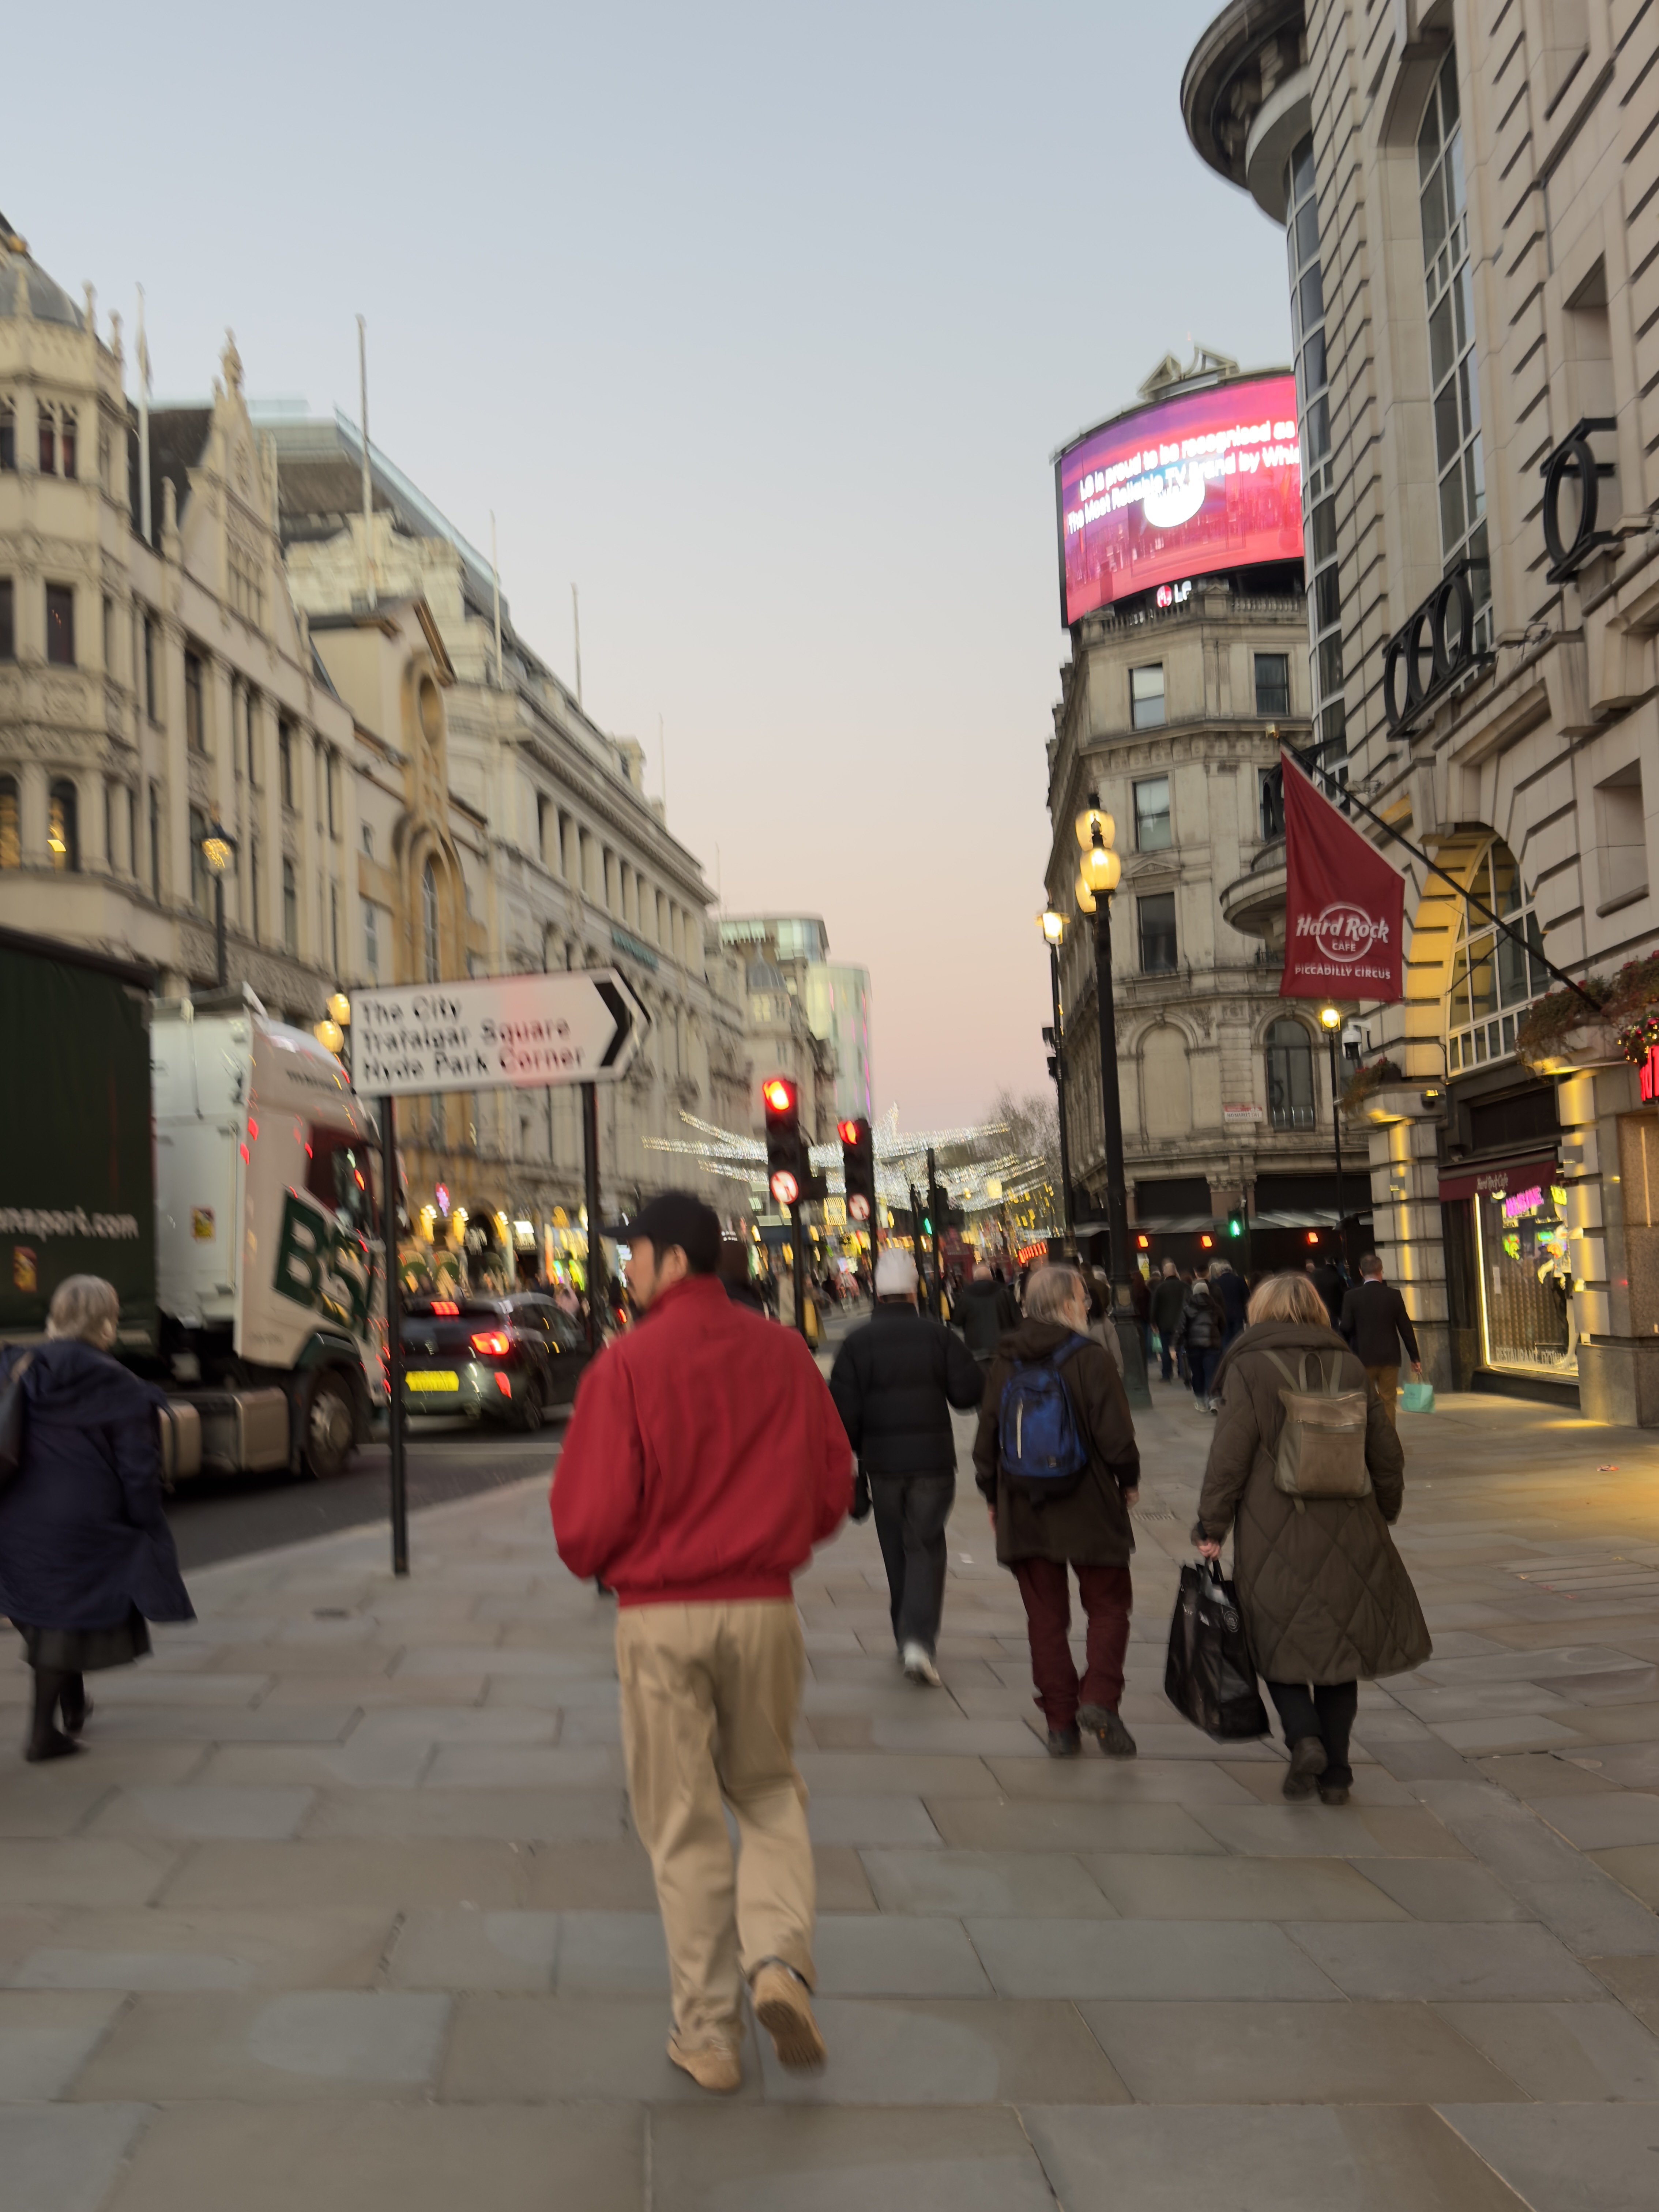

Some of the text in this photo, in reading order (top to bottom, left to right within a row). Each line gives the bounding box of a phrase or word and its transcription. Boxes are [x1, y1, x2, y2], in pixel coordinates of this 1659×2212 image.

[1080, 421, 1295, 502] LG is proud to be recognised as
[1068, 509, 1085, 534] The
[1084, 492, 1111, 522] Most
[1112, 473, 1164, 510] Reliable
[1165, 464, 1186, 486] TV
[1188, 453, 1235, 481] Brand
[1239, 451, 1260, 474] by
[1296, 913, 1389, 943] Hard Rock
[1332, 941, 1356, 952] CAFE
[1295, 965, 1391, 979] PICCADILLY CIRCUS
[360, 995, 462, 1026] The City
[360, 1018, 571, 1055] Trafalgar Square
[362, 1054, 425, 1084] Hyde
[433, 1049, 489, 1079] Park
[499, 1045, 585, 1074] Corner
[1496, 1346, 1538, 1364] RESTAURANT
